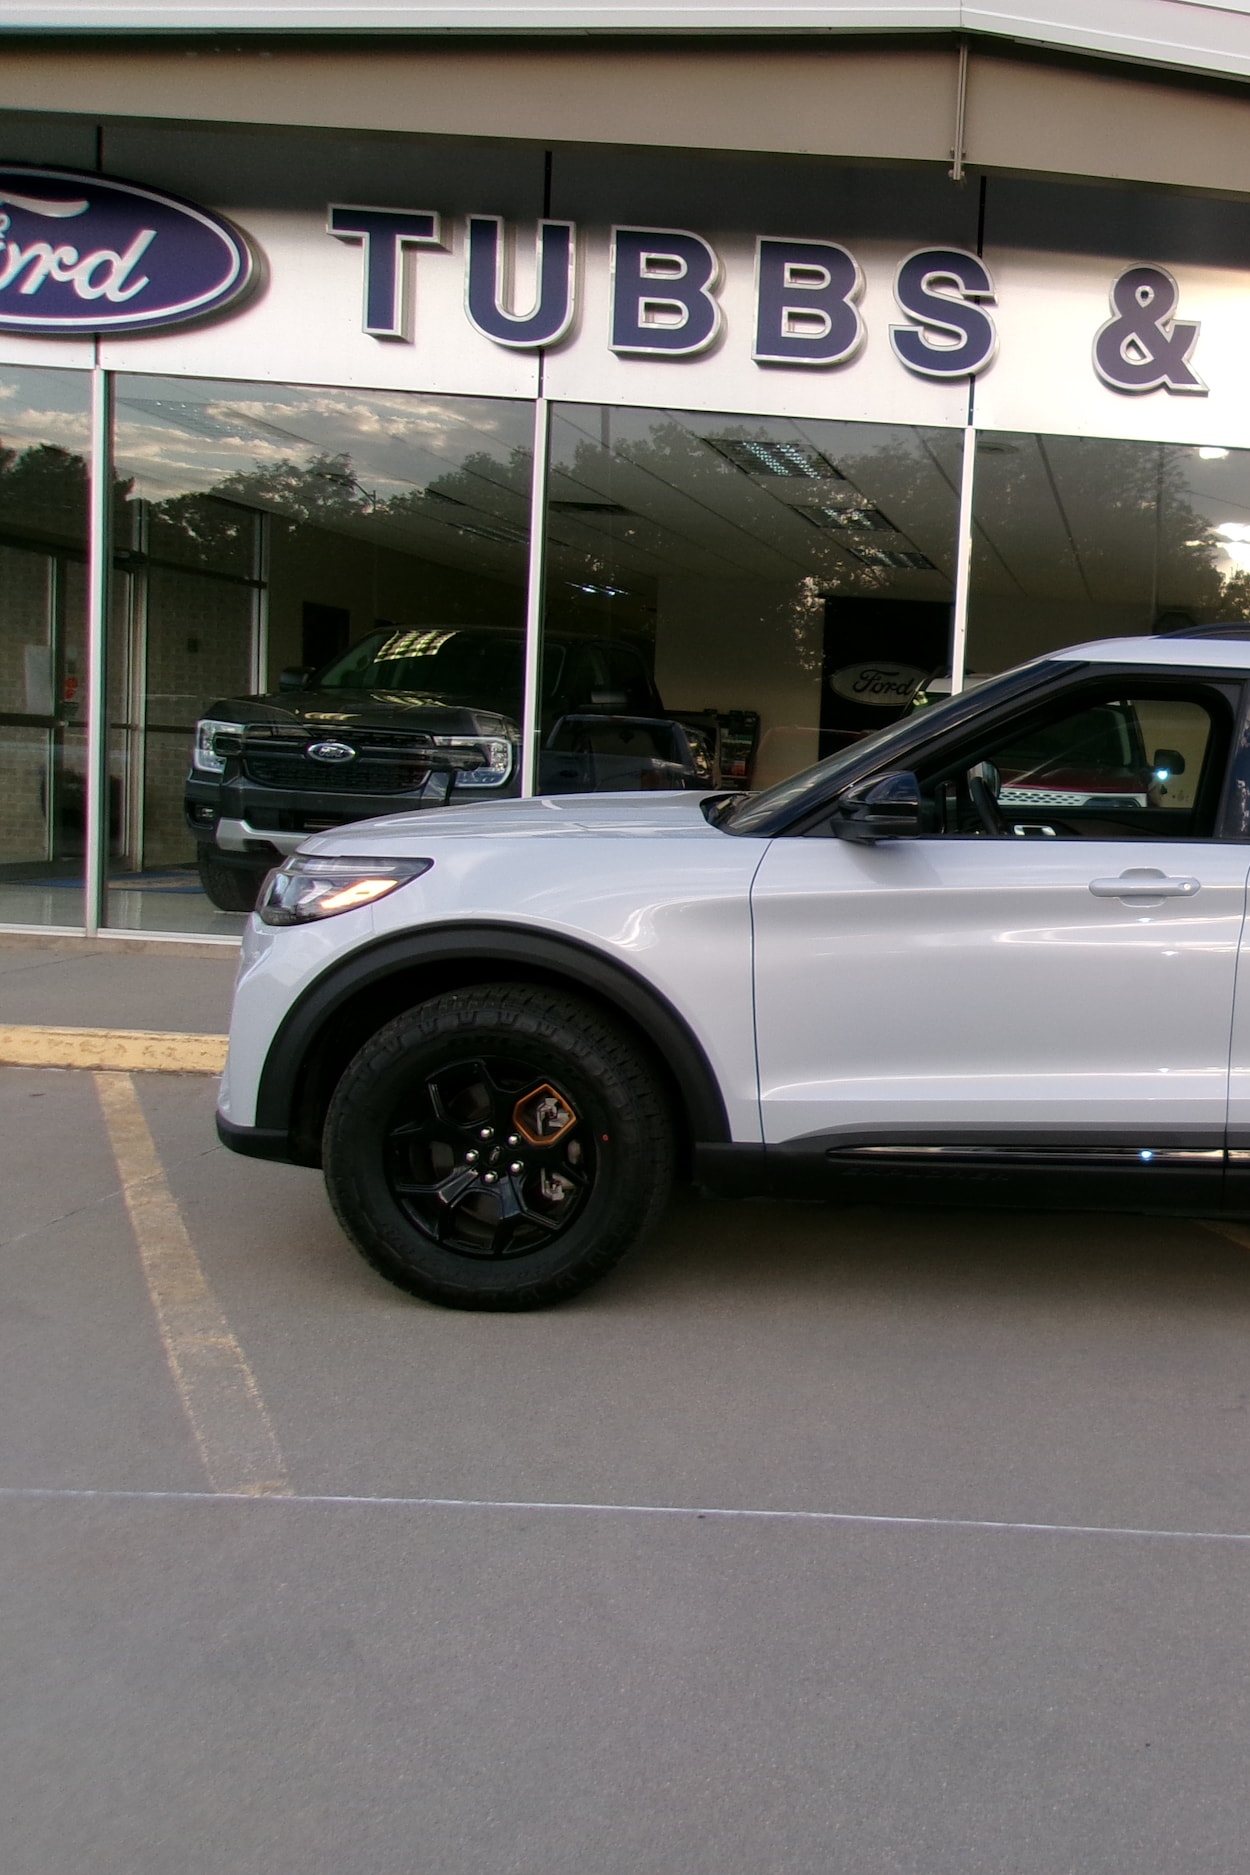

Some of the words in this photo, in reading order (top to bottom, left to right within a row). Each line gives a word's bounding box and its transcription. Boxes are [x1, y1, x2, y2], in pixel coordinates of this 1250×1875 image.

[326, 205, 998, 378] TUBBS
[1092, 262, 1209, 396] &
[853, 669, 916, 695] Ford
